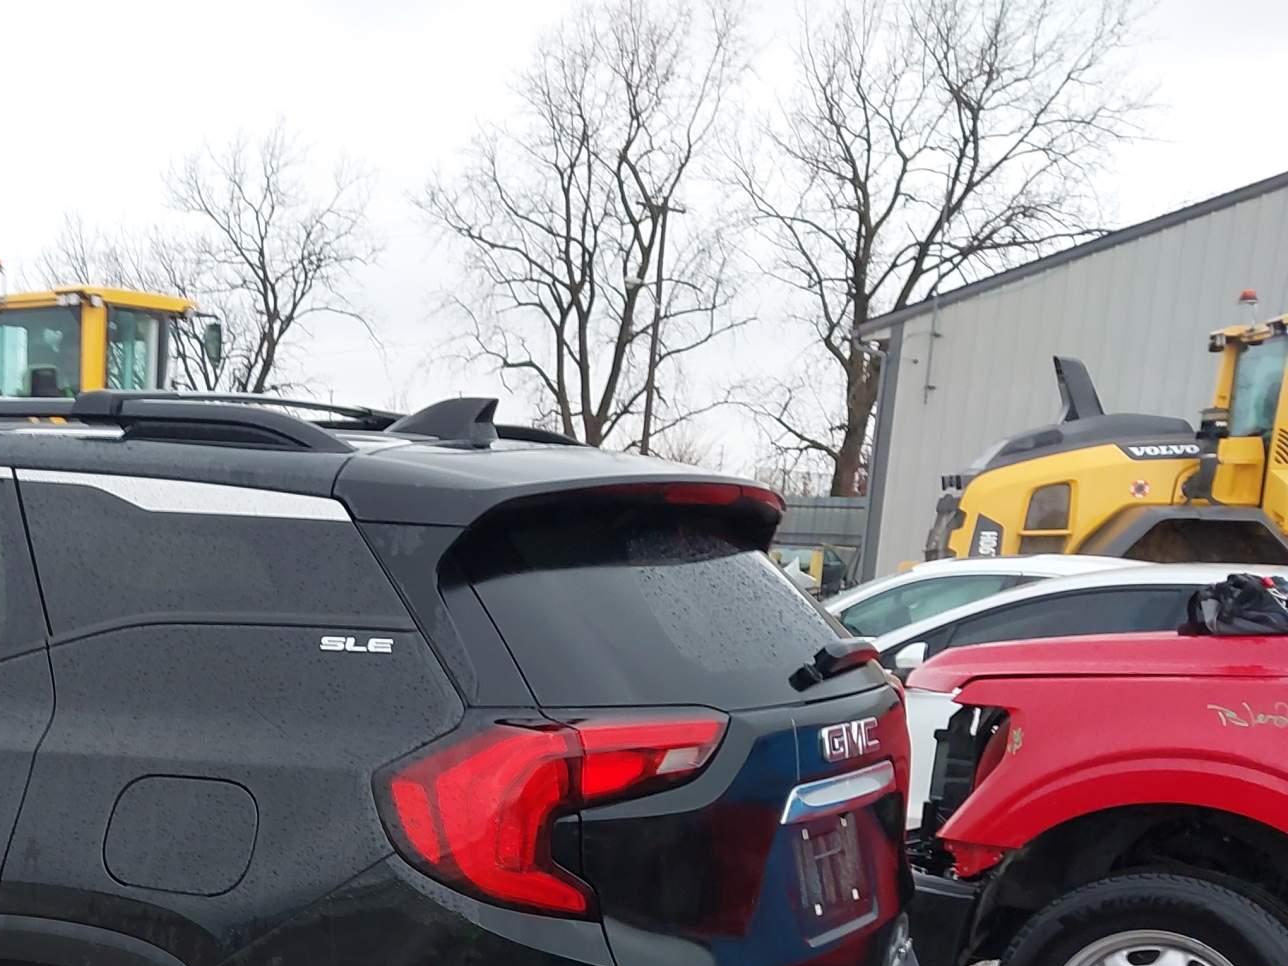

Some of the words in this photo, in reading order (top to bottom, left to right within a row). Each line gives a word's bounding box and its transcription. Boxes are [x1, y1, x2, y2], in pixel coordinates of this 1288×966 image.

[1128, 444, 1200, 456] VOLVO
[319, 636, 394, 653] SLE
[819, 717, 880, 762] GMC
